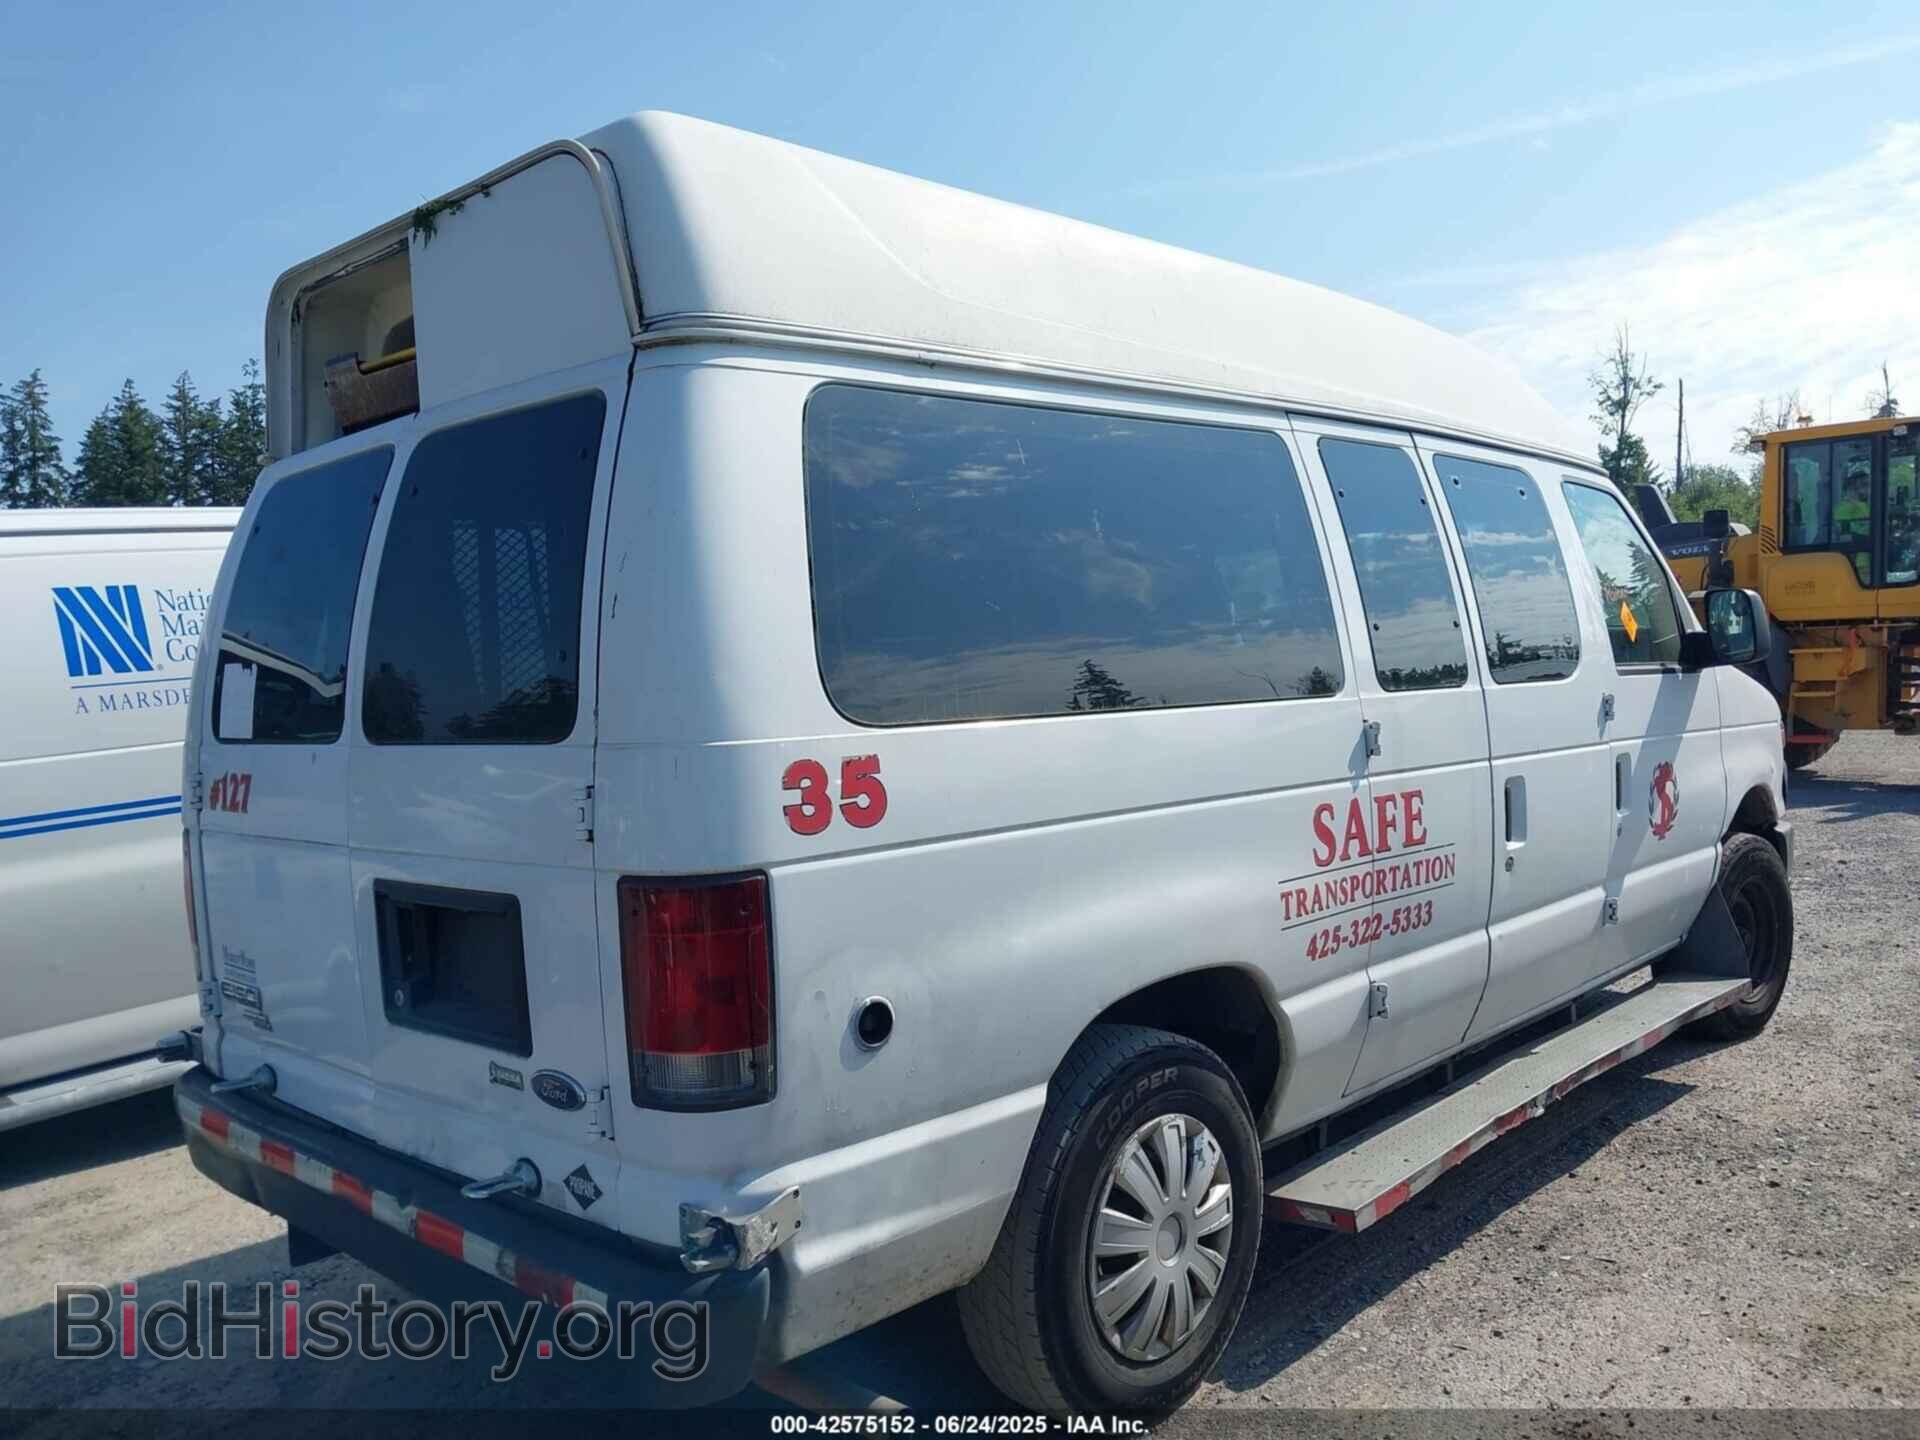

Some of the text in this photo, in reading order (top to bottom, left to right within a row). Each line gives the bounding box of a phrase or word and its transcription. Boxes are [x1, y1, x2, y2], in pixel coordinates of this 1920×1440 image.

[75, 697, 89, 715] A
[209, 770, 252, 814] #127
[782, 753, 888, 836] 35
[1312, 790, 1427, 867] SAFE
[1280, 853, 1456, 921] TRANSPORTATION
[1306, 900, 1433, 961] 425-322-5333
